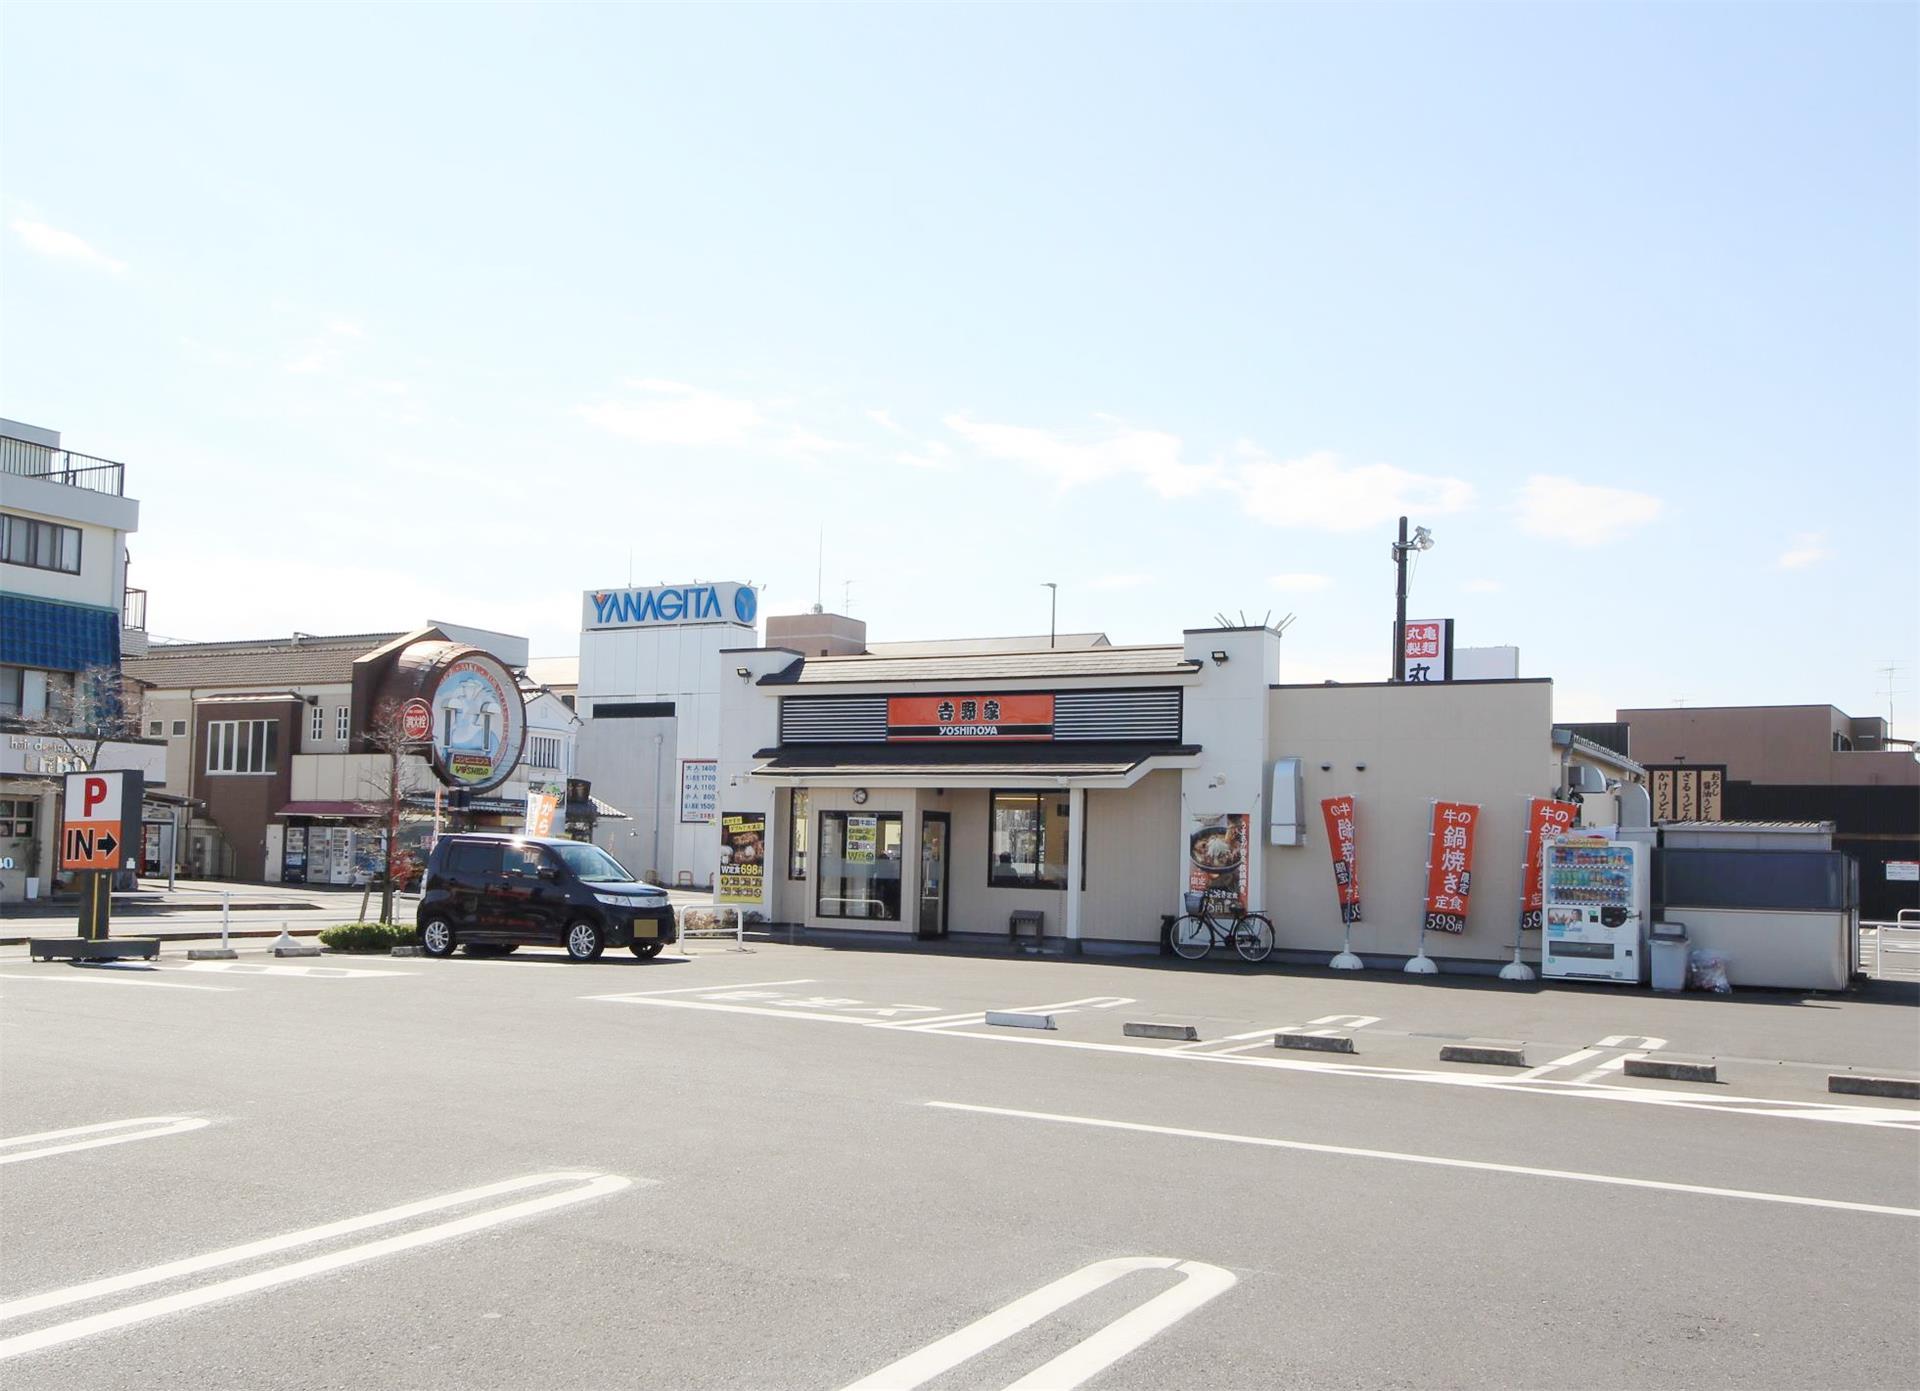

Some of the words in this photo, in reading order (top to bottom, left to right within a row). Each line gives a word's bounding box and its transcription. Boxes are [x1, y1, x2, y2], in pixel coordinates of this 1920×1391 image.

[591, 586, 722, 623] YANAGITA
[1407, 626, 1437, 640] 丸亀
[937, 700, 1000, 721] 吉野家
[939, 726, 998, 735] YOSHINOYA
[84, 777, 107, 817] P
[1443, 809, 1471, 824] 牛の
[1540, 806, 1569, 823] 牛の
[66, 828, 95, 861] IN
[1441, 825, 1467, 894] 鍋焼き
[1459, 872, 1471, 895] 限定
[1435, 896, 1463, 911] 定食
[1426, 914, 1463, 933] 598円
[1523, 911, 1543, 929] 59
